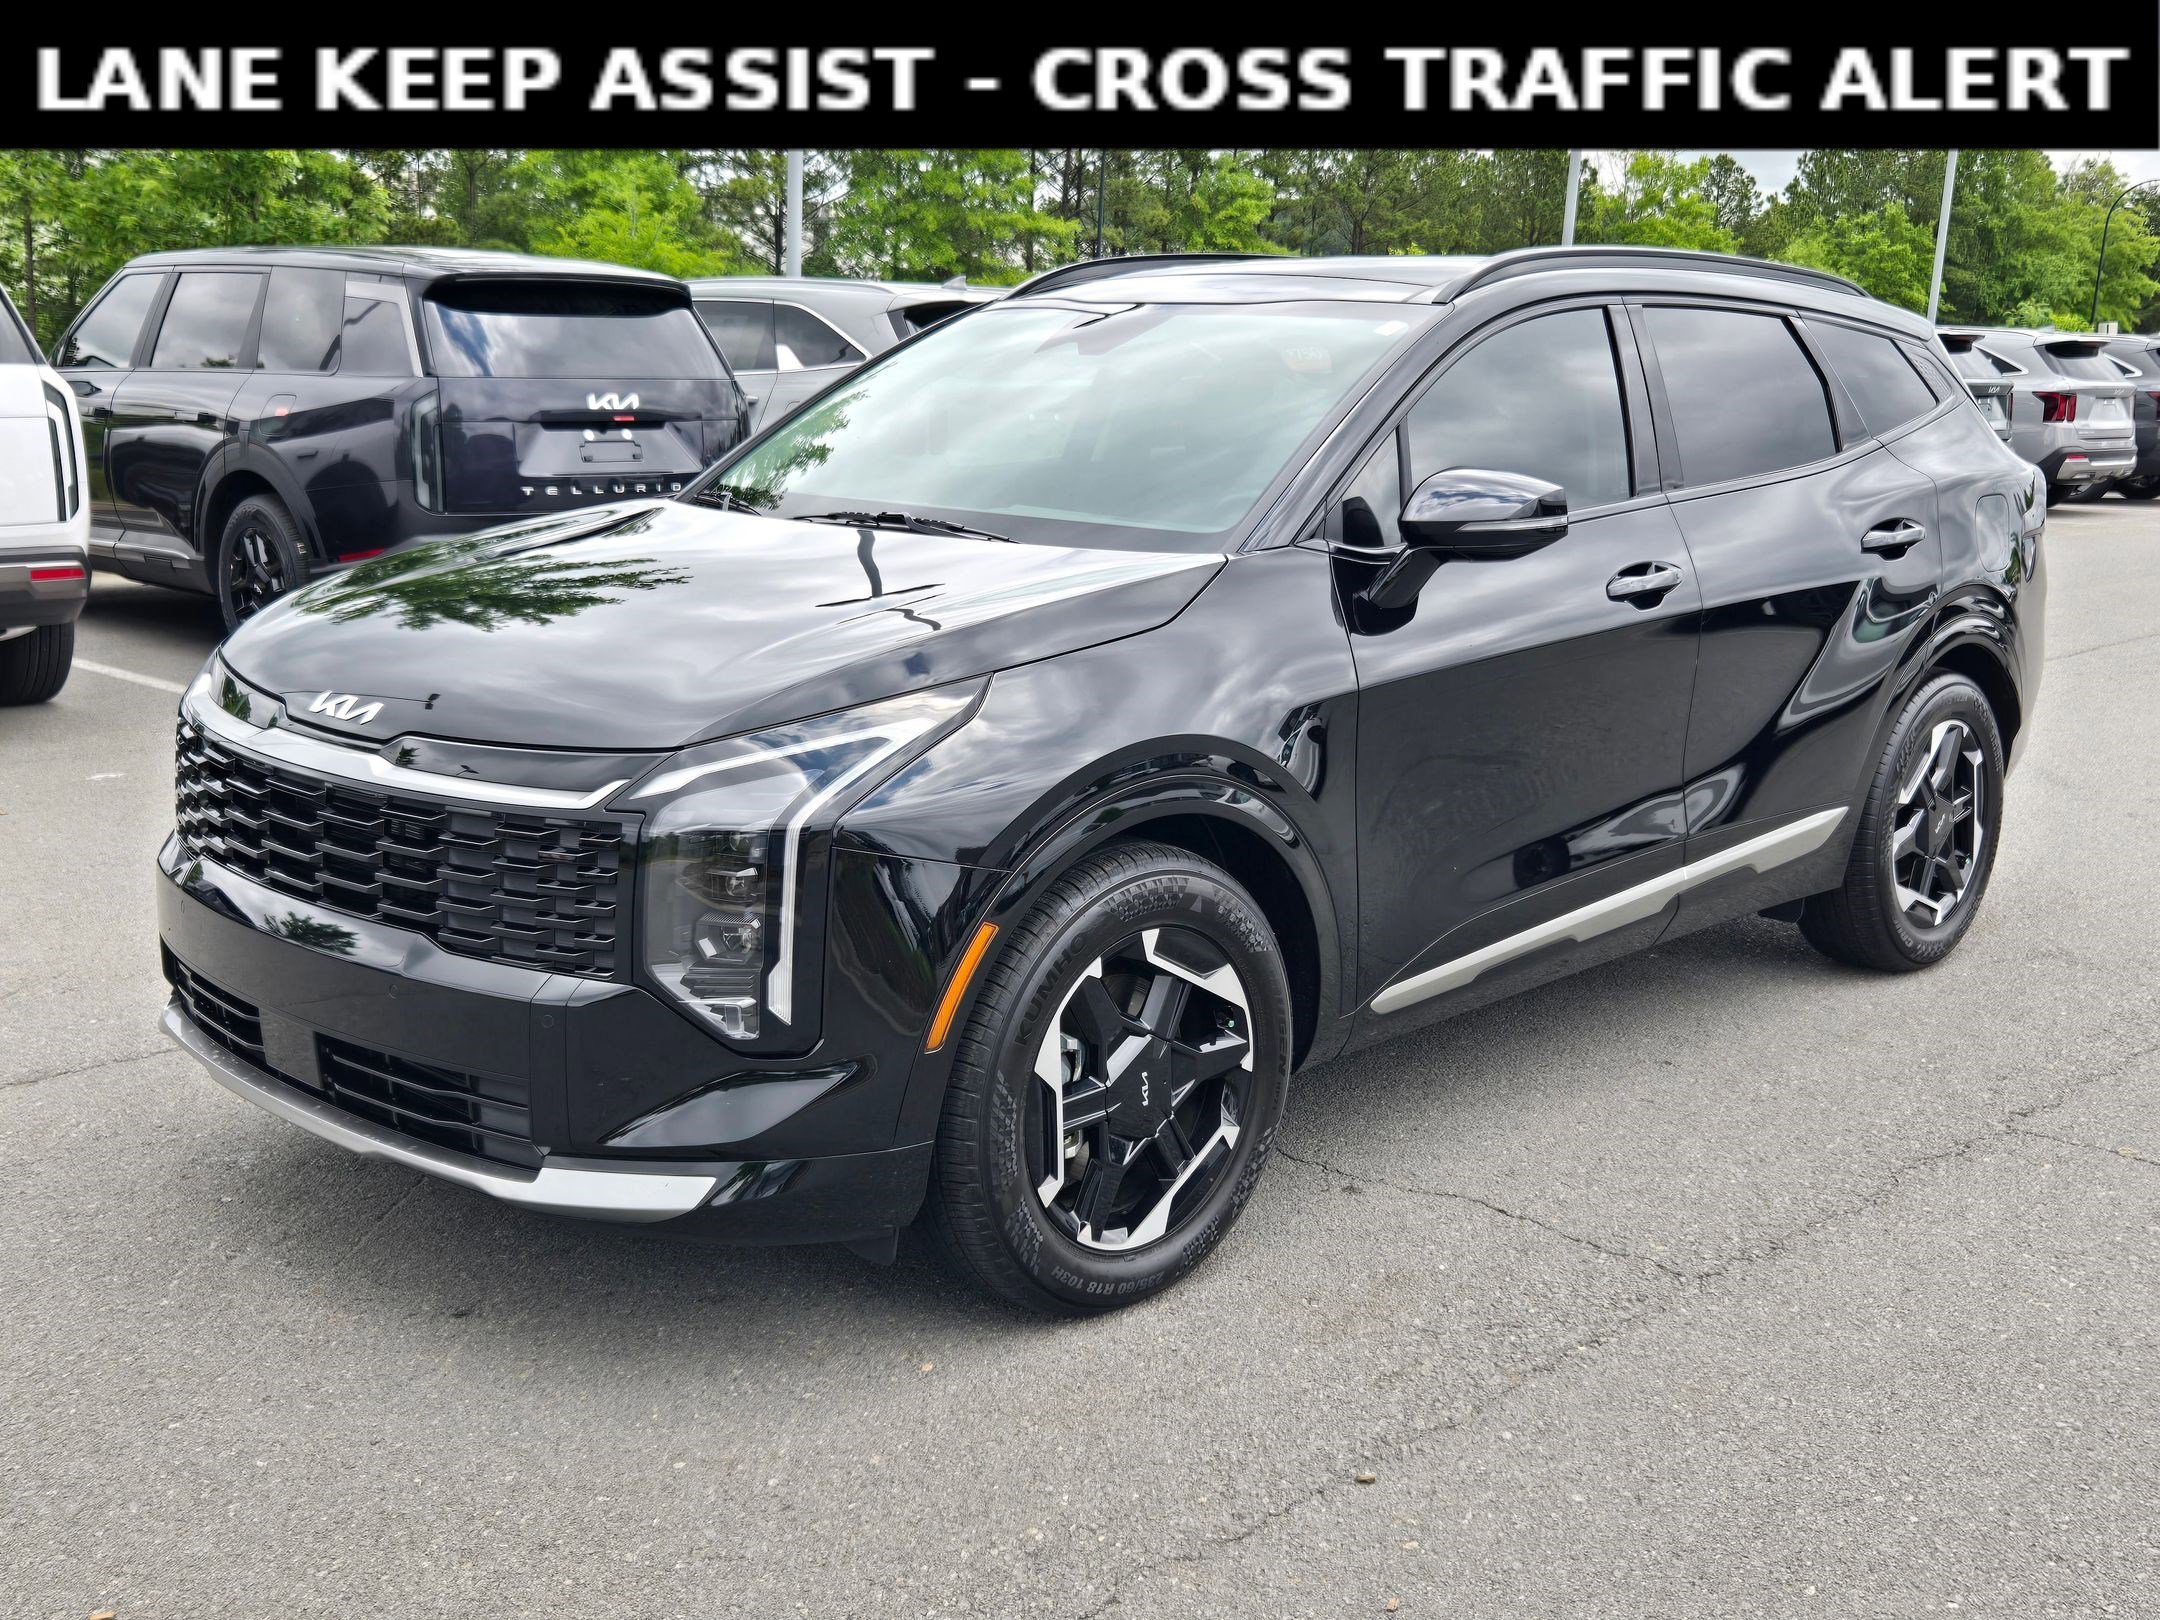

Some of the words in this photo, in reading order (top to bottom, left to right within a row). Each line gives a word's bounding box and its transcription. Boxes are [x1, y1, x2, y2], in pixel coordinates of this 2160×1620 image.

[586, 392, 640, 411] KIA
[520, 482, 683, 497] TELLURID
[308, 690, 385, 726] KIA
[1014, 934, 1087, 1046] KUMHO
[1141, 1071, 1149, 1107] KIA
[1050, 1265, 1084, 1289] 103H
[1086, 1281, 1116, 1296] R18
[1117, 1271, 1165, 1295] 235/60
